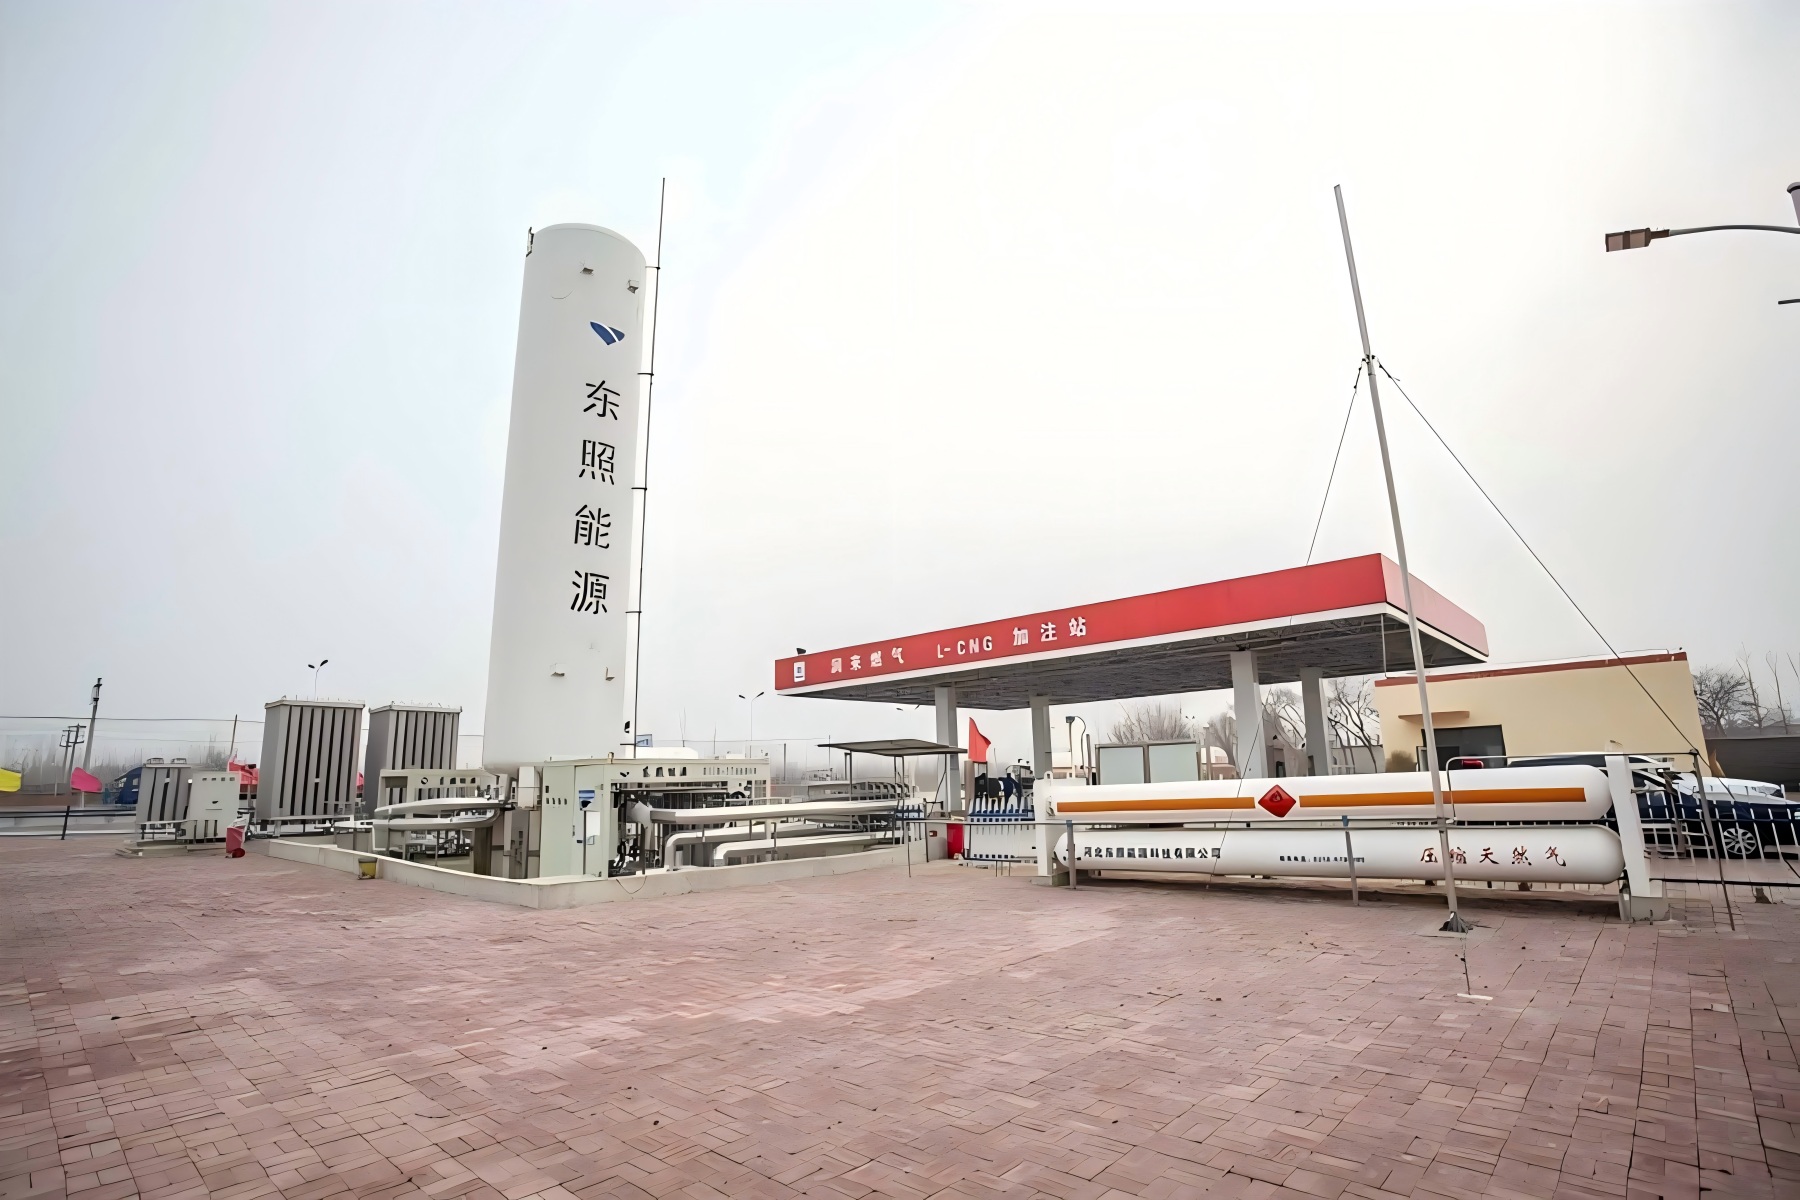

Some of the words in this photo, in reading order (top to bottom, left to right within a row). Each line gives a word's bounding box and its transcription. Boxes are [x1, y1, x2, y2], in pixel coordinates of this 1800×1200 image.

[570, 379, 621, 615] 东照能源
[937, 635, 993, 659] L-CNG
[1012, 616, 1087, 646] 加注站
